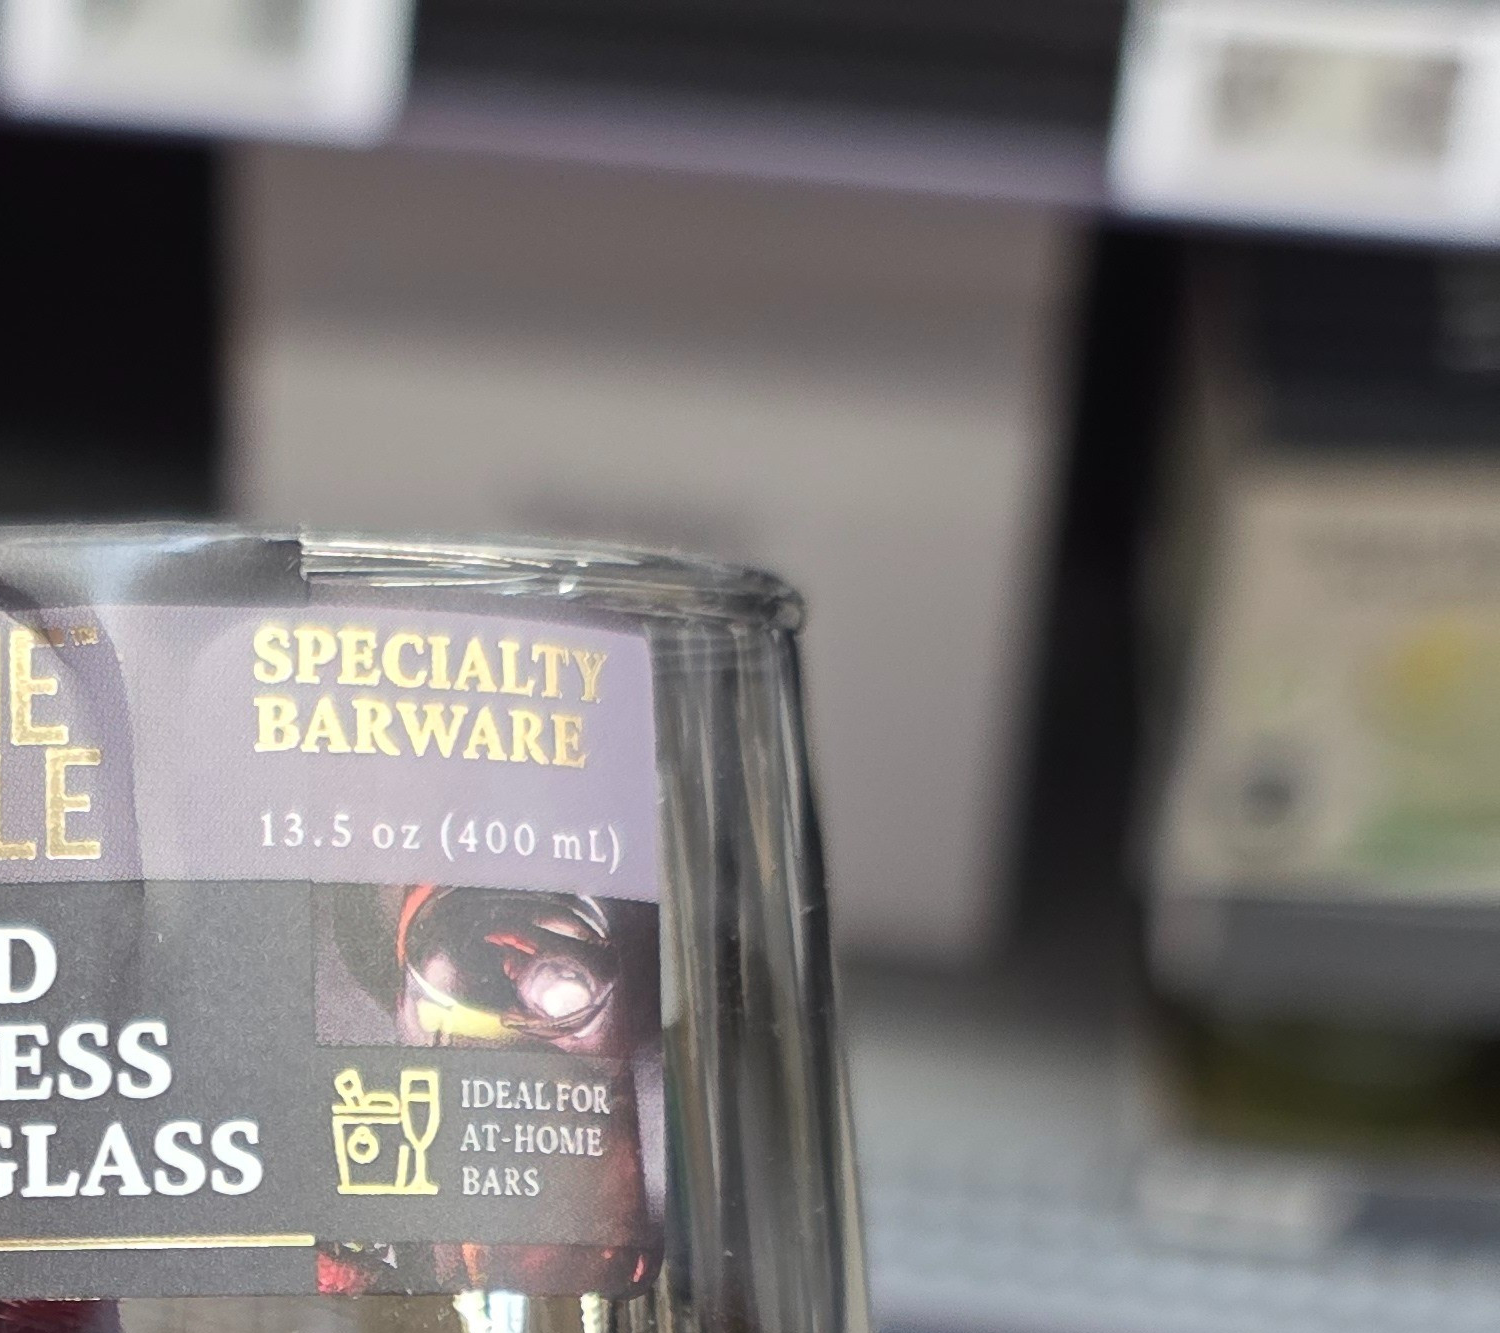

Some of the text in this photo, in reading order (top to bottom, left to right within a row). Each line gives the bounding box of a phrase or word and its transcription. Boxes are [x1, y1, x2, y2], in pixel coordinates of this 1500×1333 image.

[252, 626, 607, 704] SPECIALTY
[253, 696, 587, 769] BARWARE
[260, 811, 622, 874] 13.5 oz (400 mL)
[461, 1079, 611, 1115] IDEAL FOR
[460, 1123, 604, 1157] AT-HOME
[462, 1165, 541, 1197] BARS
